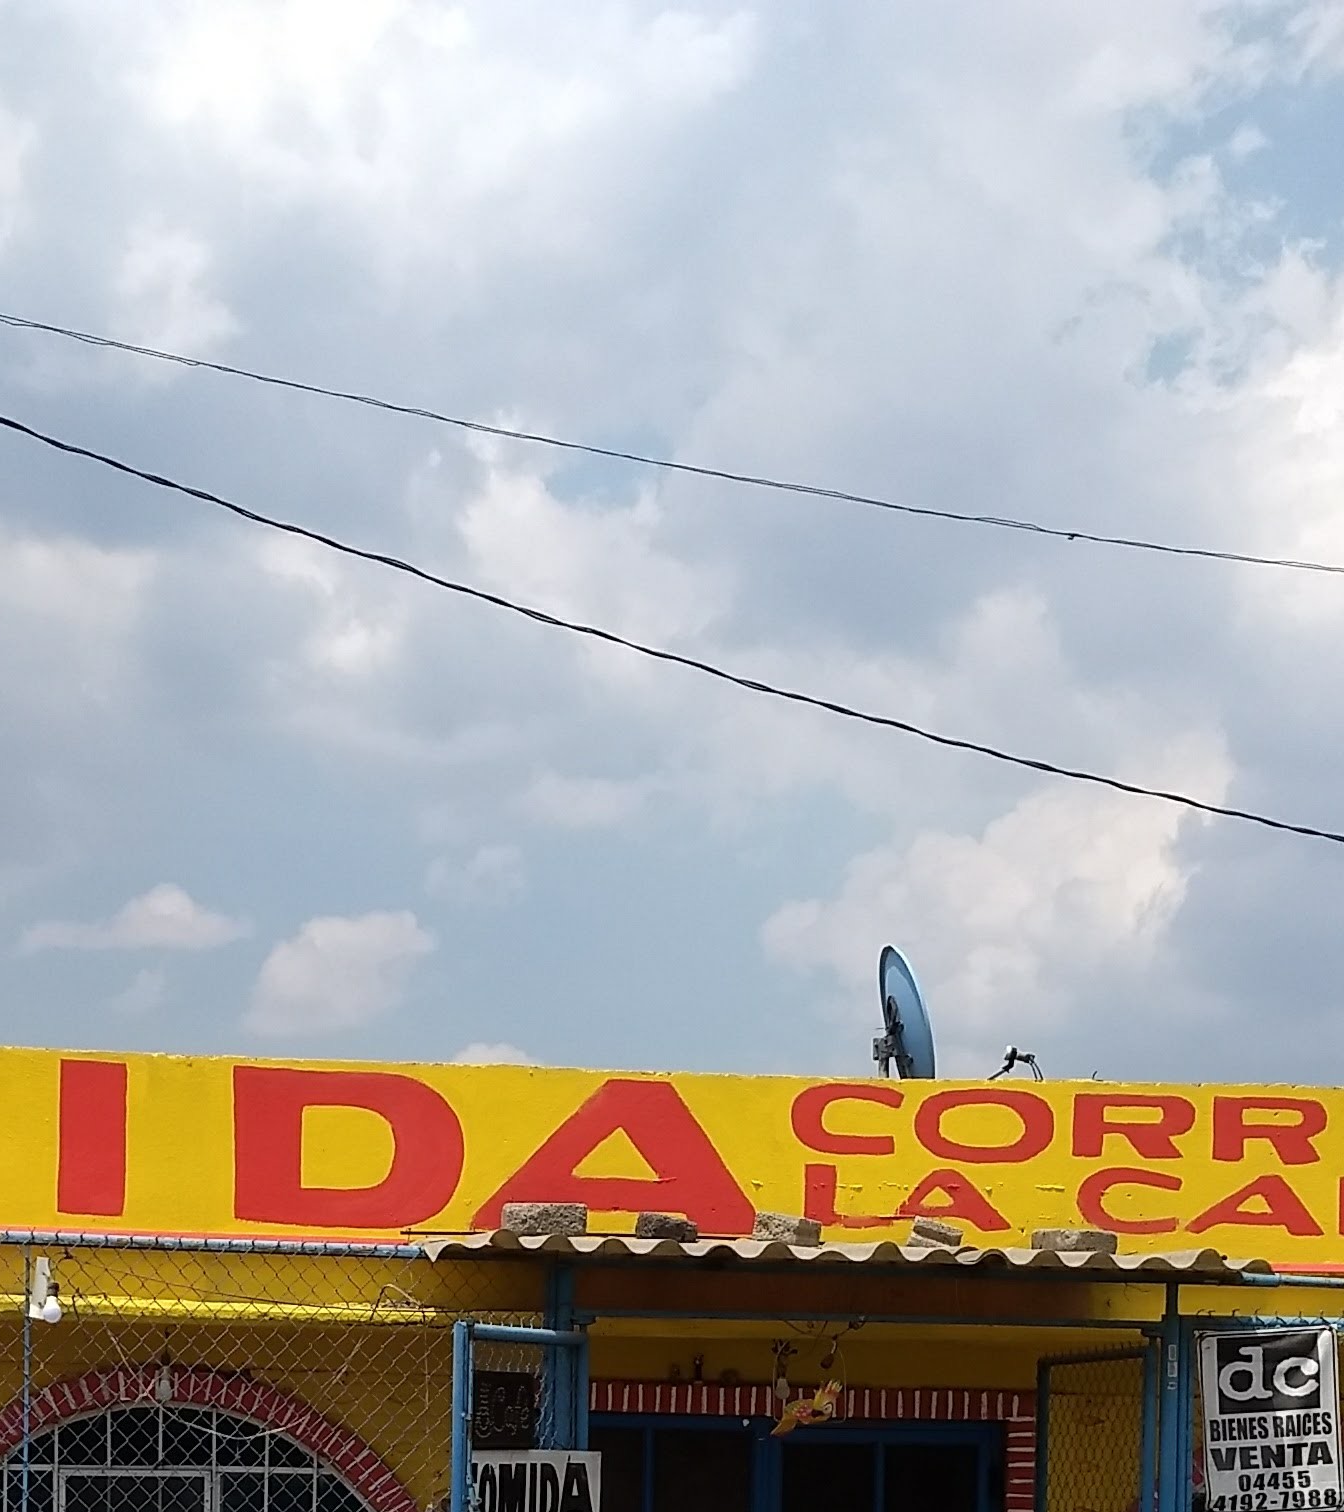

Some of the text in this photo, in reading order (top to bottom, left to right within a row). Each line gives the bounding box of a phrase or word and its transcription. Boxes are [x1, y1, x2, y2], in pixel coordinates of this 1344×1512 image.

[803, 1162, 1012, 1233] LA
[1219, 1345, 1320, 1401] dc
[1209, 1411, 1333, 1442] BIENES RAICES
[1209, 1441, 1334, 1472] VENTA
[1238, 1470, 1312, 1492] 04455
[1212, 1489, 1338, 1512] 4192-7988
